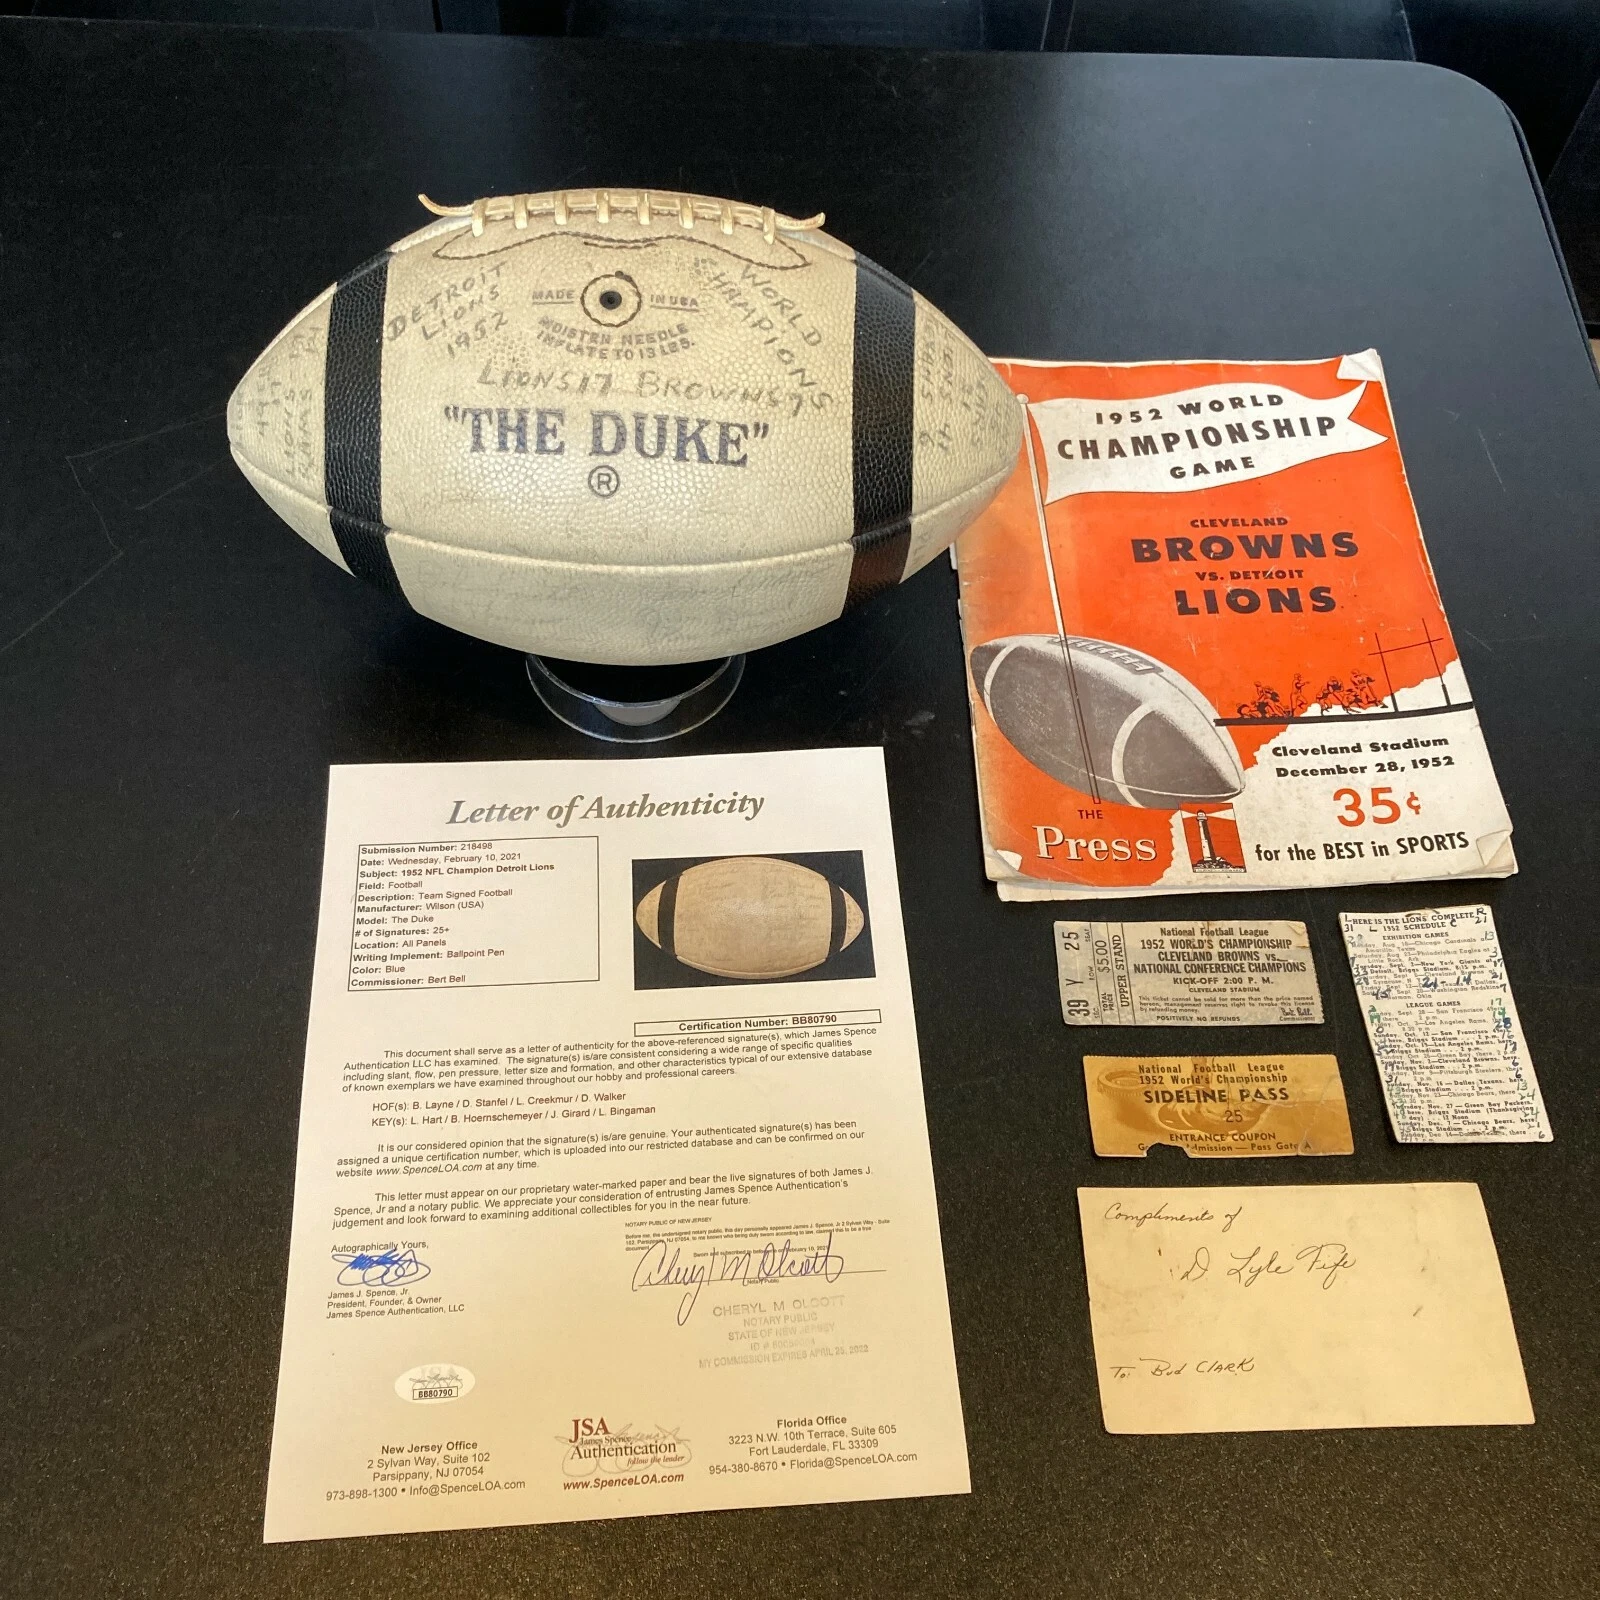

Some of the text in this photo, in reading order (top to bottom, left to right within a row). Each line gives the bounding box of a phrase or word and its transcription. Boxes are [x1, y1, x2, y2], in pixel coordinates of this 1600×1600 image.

[387, 261, 505, 341] DETROIT
[532, 289, 575, 301] MADE
[739, 264, 822, 348] WORLD
[447, 312, 509, 358] 1952
[538, 316, 689, 346] MOISTEN NEEDLE
[1096, 394, 1285, 425] 1952 WORLD
[1057, 416, 1337, 461] CHAMPIONSHIP
[1169, 456, 1255, 480] GAME
[1190, 516, 1288, 528] CLEVELAND
[1131, 531, 1360, 564] BROWNS
[1196, 568, 1305, 581] VS. DETROIT
[1175, 587, 1338, 617] LIONS
[1272, 735, 1450, 757] Cleveland Stadium
[1275, 756, 1455, 778] December 28, 1952
[445, 791, 765, 829] Letter of Authenticity
[1077, 809, 1104, 820] THE
[1332, 786, 1422, 827] 35¢
[361, 842, 492, 855] Submission Number: 218498
[1032, 825, 1157, 863] Press
[1255, 832, 1470, 863] for the BEST in SPORTS
[361, 858, 384, 866] Date:
[388, 856, 441, 866] Wednesday,
[444, 854, 482, 864] February
[485, 853, 498, 862] 10,
[360, 863, 555, 879] Subject: 1952 NFL Champion Detroit Lions
[1404, 921, 1446, 930] SCHEDULE
[1431, 913, 1475, 921] COMPLETE
[1062, 931, 1080, 951] 25
[1160, 927, 1269, 937] National Football League
[1383, 933, 1422, 941] EXHIBITION
[1141, 939, 1292, 950] 1952 WORLD'S CHAMPIONSHIP
[1097, 940, 1111, 973] $5.00
[1158, 951, 1279, 961] CLEVELAND BROWNS vs.
[1112, 934, 1131, 1008] UPPER STAND
[1134, 963, 1306, 974] NATIONAL CONFERENCE CHAMPIONS
[1173, 977, 1218, 985] KICK-OFF
[1067, 999, 1091, 1017] 39
[679, 1014, 837, 1031] Certification Number: BB80790
[1138, 1063, 1285, 1074] National Football League
[1140, 1074, 1288, 1085] 1952 World's Championship
[1143, 1088, 1290, 1104] SIDELINE PASS
[1224, 1111, 1243, 1123] 25
[1170, 1132, 1276, 1141] ENTRANCE COUPON
[1104, 1202, 1243, 1231] Compliments of
[1226, 1246, 1294, 1287] Lyle
[1139, 1357, 1183, 1377] Bud
[418, 1388, 453, 1398] BB80790
[569, 1417, 611, 1443] JSA
[777, 1415, 847, 1429] Florida Office
[728, 1424, 897, 1445] 3223 N.W. 10th Terrace, Suite 605
[381, 1441, 478, 1455] New Jersey Office
[570, 1441, 677, 1460] Authentication
[749, 1438, 879, 1457] Fort Lauderdale, FL 33309
[367, 1453, 490, 1470] 2 Sylvan Way, Suite 102
[709, 1452, 918, 1476] 954-380-8670 Florida@SpenceLOA.com
[372, 1466, 484, 1482] Parsippany, NJ 07054
[563, 1472, 684, 1491] www.SpenceLOA.com
[326, 1479, 526, 1501] 973-898-1300 Info@SpenceLOA.com
